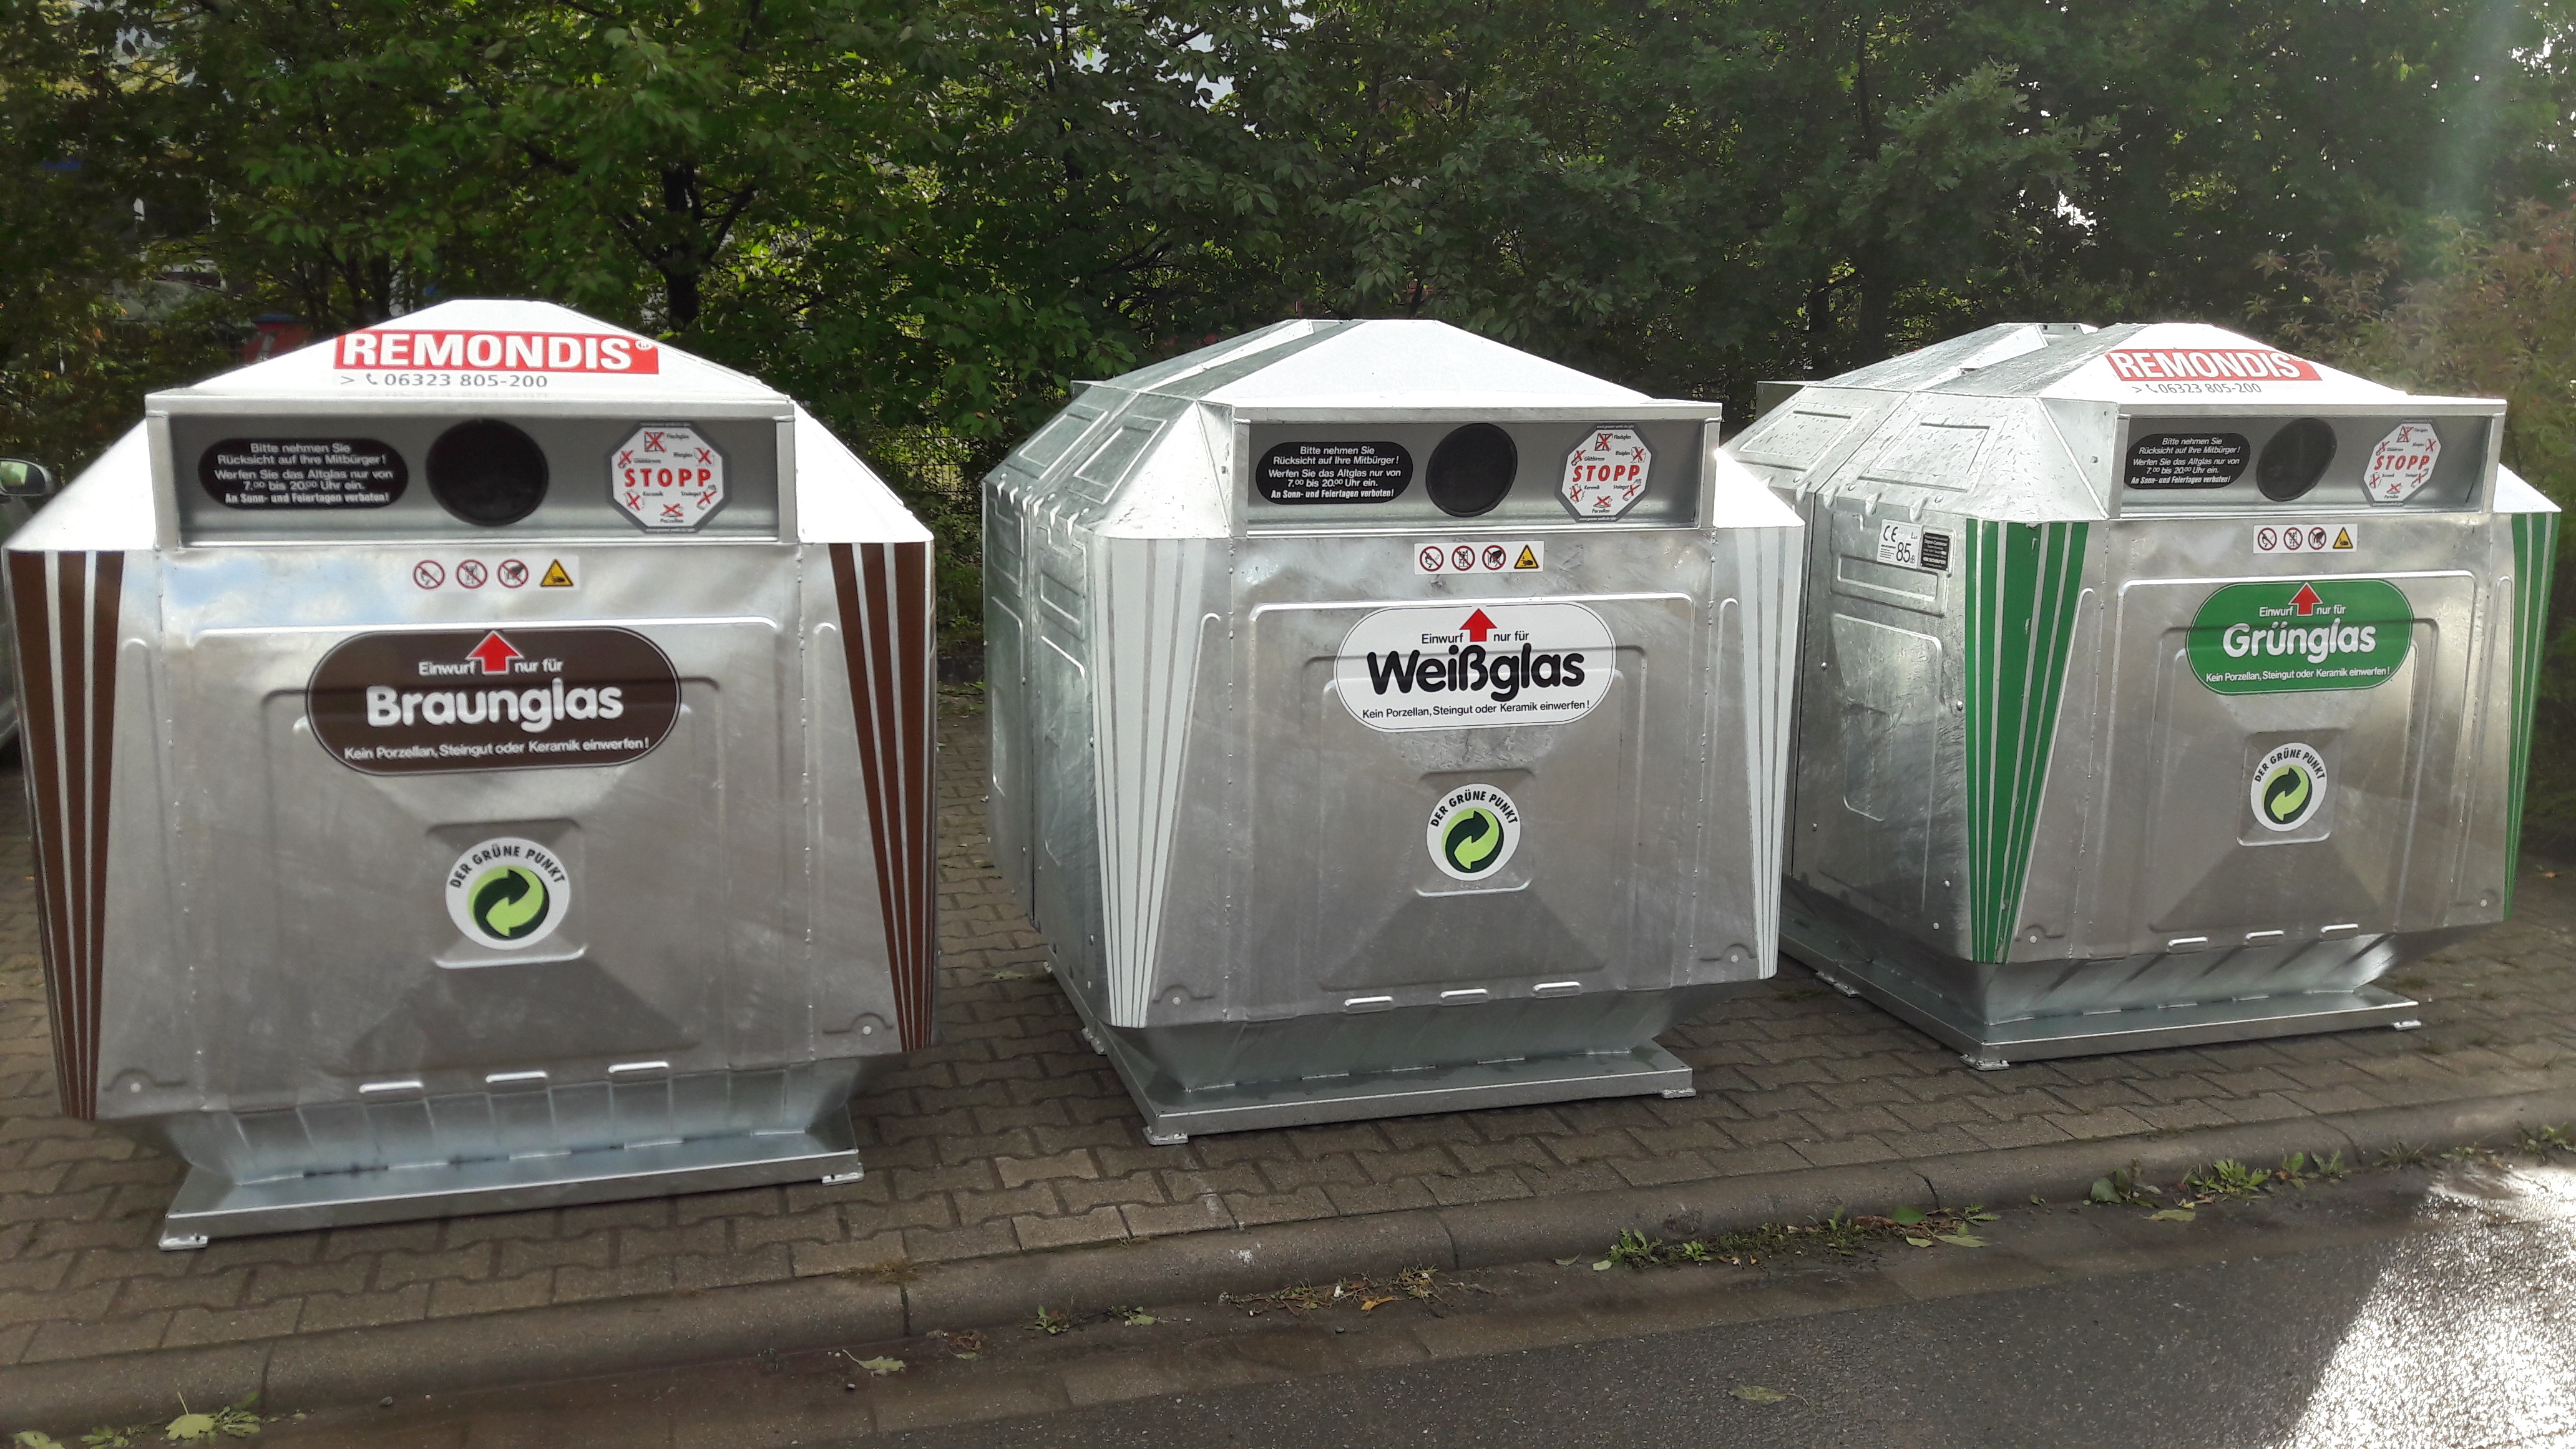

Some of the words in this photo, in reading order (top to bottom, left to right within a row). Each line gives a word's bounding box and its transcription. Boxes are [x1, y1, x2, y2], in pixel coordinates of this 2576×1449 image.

[385, 374, 450, 386] 06323
[461, 374, 547, 388] 805-200
[2160, 384, 2202, 393] 06323
[2205, 383, 2262, 393] 805-200
[251, 443, 278, 453] Bitte
[282, 443, 329, 453] nehmen
[331, 443, 351, 453] Sie
[1300, 446, 1320, 454] Bitte
[1323, 446, 1359, 454] nehmen
[1360, 446, 1375, 454] Sie
[218, 454, 275, 464] Rücksicht
[278, 454, 296, 464] auf
[300, 454, 322, 464] Ihre
[1273, 456, 1316, 465] Rücksicht
[1318, 456, 1333, 464] auf
[1334, 456, 1351, 464] Ihre
[2187, 458, 2212, 466] Altglas
[2374, 455, 2430, 470] STOPP
[214, 469, 256, 479] Werfen
[260, 469, 278, 479] Sie
[282, 469, 303, 479] das
[307, 469, 346, 481] Altglas
[350, 471, 368, 479] nur
[372, 471, 393, 479] von
[625, 468, 711, 487] STOPP
[1269, 469, 1299, 478] Werfen
[1302, 469, 1316, 477] Sie
[1319, 469, 1334, 477] das
[1337, 469, 1367, 479] Altglas
[1573, 465, 1640, 482] STOPP
[2171, 476, 2202, 484] Feiertagen
[268, 481, 286, 490] bis
[320, 481, 341, 490] Uhr
[344, 481, 365, 490] ein.
[1345, 479, 1360, 487] Uhr
[1363, 479, 1378, 487] ein.
[225, 493, 238, 504] An
[240, 493, 268, 504] Sonn-
[271, 493, 289, 504] und
[291, 493, 342, 504] Feiertagen
[344, 493, 390, 502] verboten!
[1271, 490, 1281, 498] An
[1283, 490, 1304, 498] Sonn-
[1305, 490, 1319, 498] und
[1322, 489, 1358, 499] Feiertagen
[1361, 489, 1393, 497] verboten!
[1883, 525, 1898, 542] CE
[1896, 542, 1911, 563] 85
[2259, 606, 2293, 617] Einwurf
[2316, 607, 2331, 615] nur
[2333, 605, 2346, 615] für
[1422, 633, 1464, 645] Einwurf
[1493, 633, 1511, 642] nur
[1515, 631, 1530, 641] für
[2222, 617, 2376, 663] Grünglas
[418, 659, 476, 676] Einwurf
[514, 660, 539, 674] nur
[543, 659, 564, 673] für
[1367, 643, 1585, 702] Weißglas
[2206, 673, 2223, 682] Kein
[2263, 670, 2295, 681] Steingut
[2296, 669, 2314, 678] oder
[2316, 668, 2348, 677] Keramik
[366, 678, 624, 734] Braunglas
[1362, 708, 1383, 719] Kein
[1386, 707, 1432, 719] Porzellan,
[1433, 705, 1473, 717] Steingut
[1475, 703, 1497, 714] oder
[1500, 702, 1538, 713] Keramik
[344, 746, 373, 761] Kein
[439, 743, 493, 759] Steingut
[495, 741, 525, 755] oder
[529, 739, 579, 753] Keramik
[2255, 763, 2269, 782] DER
[2270, 748, 2301, 764] GRÜNE
[2303, 752, 2326, 779] PUNKT
[1430, 806, 1448, 827] DER
[1449, 789, 1486, 807] GRÜNE
[1489, 794, 1518, 823] PUNKT
[449, 863, 472, 889] DER
[472, 844, 521, 864] GRÜNE
[525, 849, 566, 883] PUNKT
